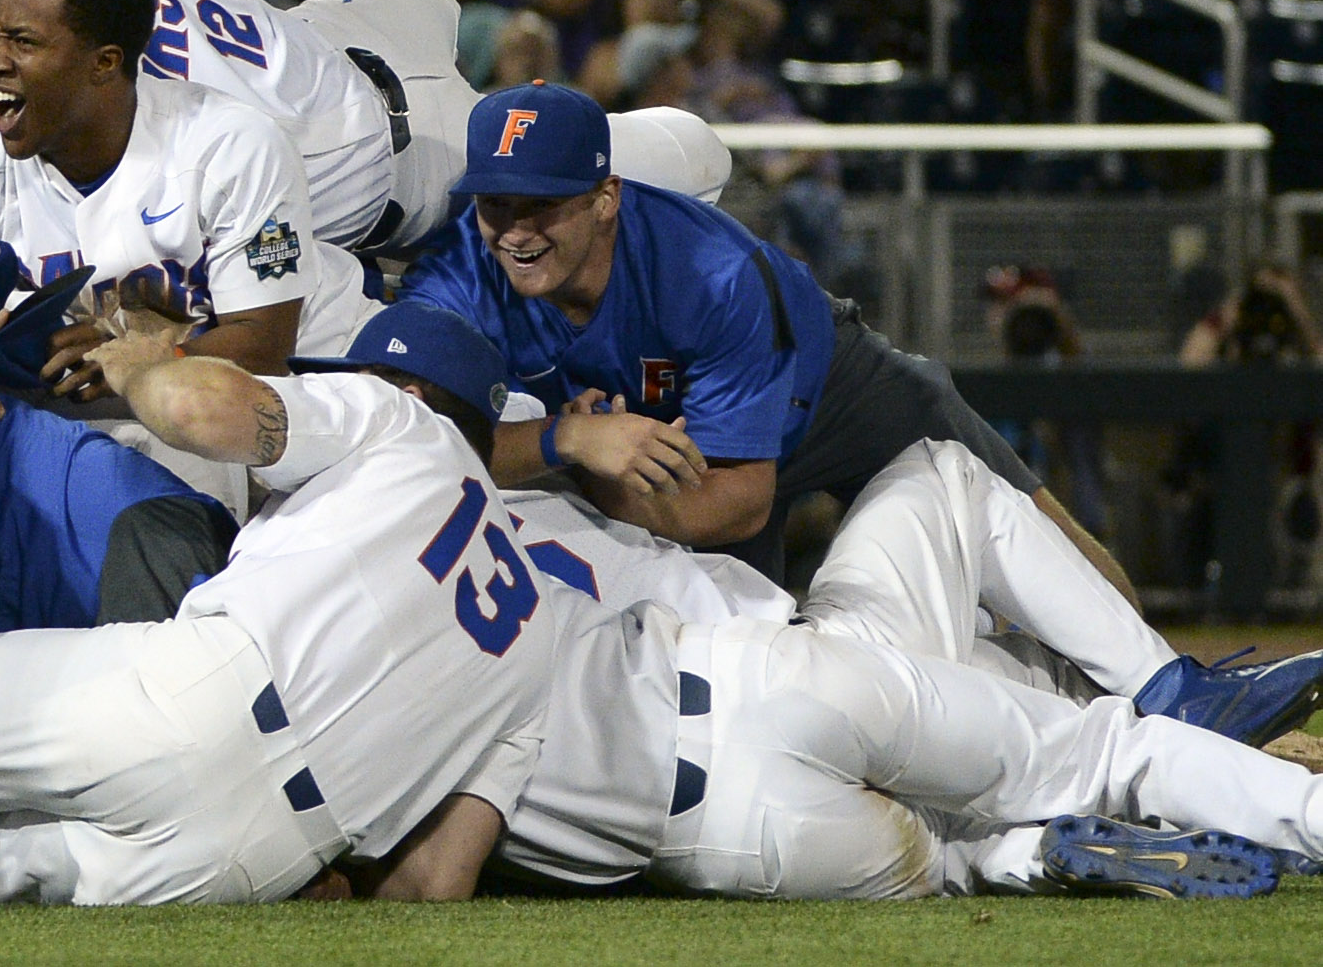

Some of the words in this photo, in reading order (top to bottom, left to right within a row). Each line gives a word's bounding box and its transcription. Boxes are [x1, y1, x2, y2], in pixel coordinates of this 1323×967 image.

[492, 108, 539, 157] F
[249, 253, 276, 267] WORLD
[259, 241, 289, 256] COLLEGE
[639, 355, 679, 407] F
[416, 475, 541, 659] 13
